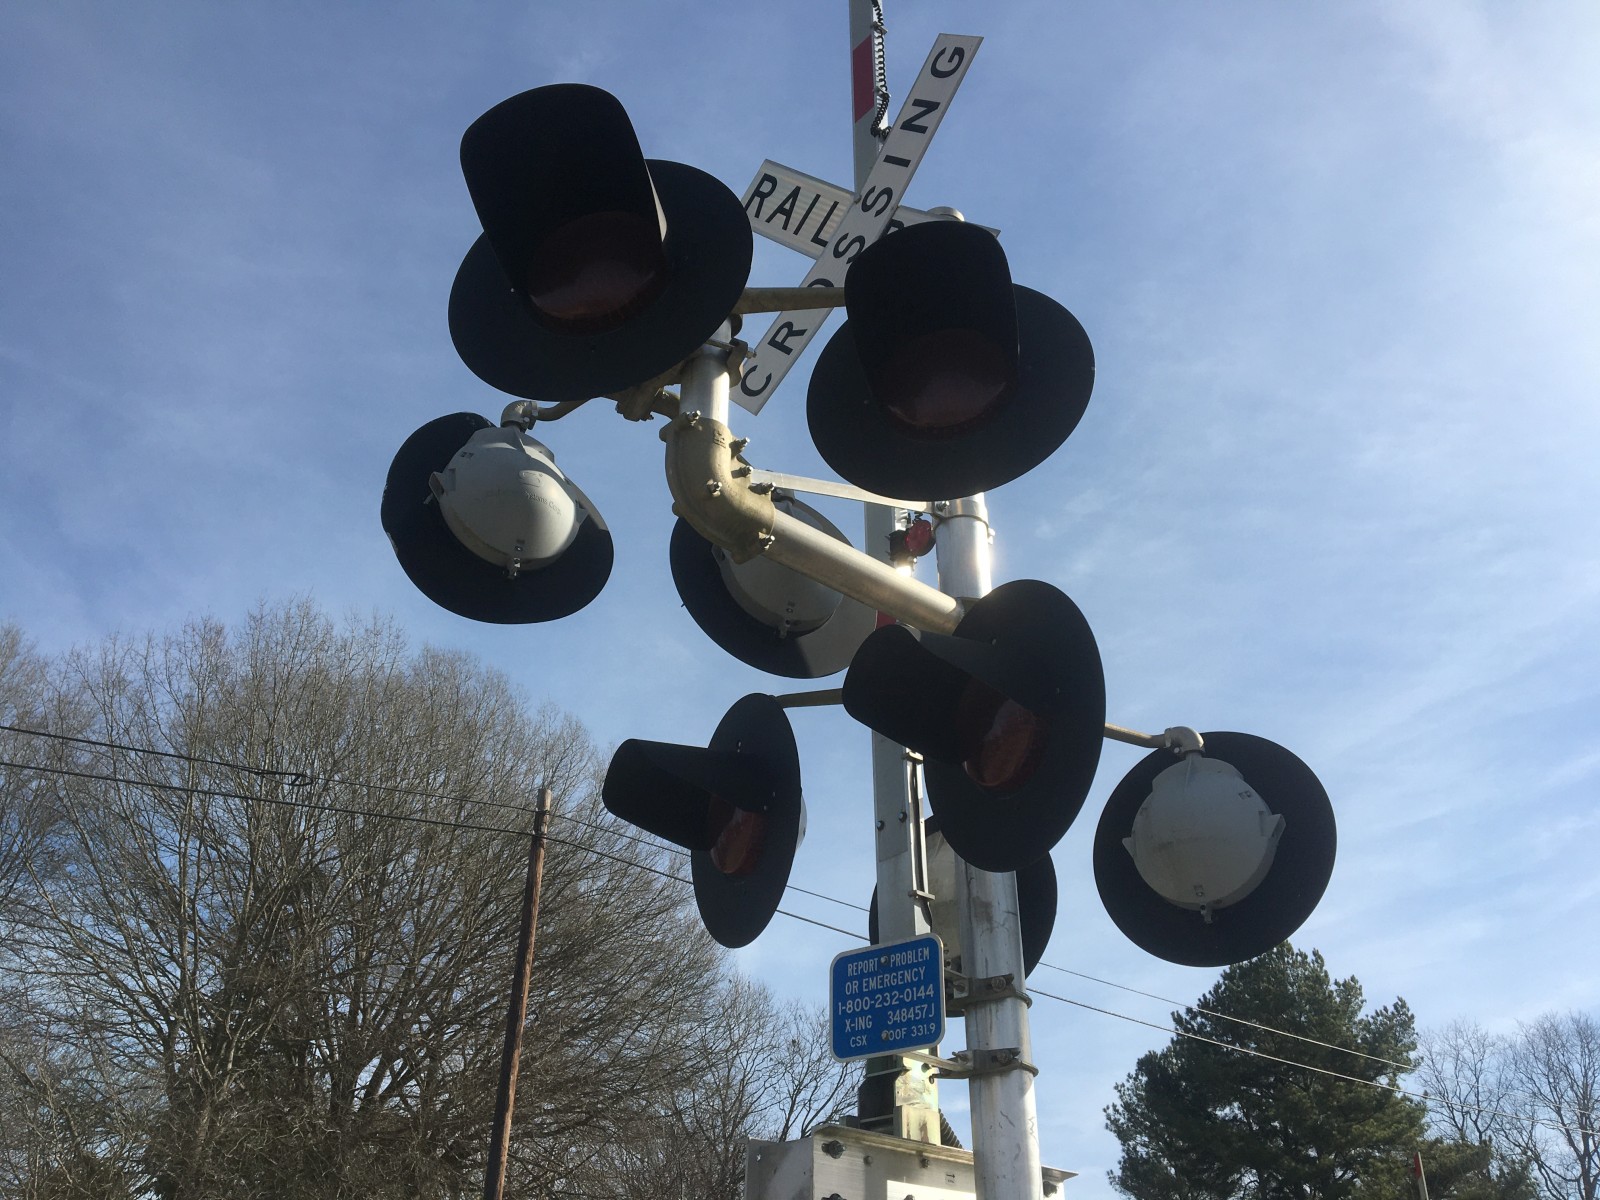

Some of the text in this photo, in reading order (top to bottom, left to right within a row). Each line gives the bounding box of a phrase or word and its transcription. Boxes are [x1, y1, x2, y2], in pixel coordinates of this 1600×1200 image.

[744, 172, 840, 248] RAIL
[847, 946, 930, 977] REPORT PROBLEM
[845, 966, 926, 996] OR EMERGENCY
[838, 983, 934, 1016] 1-800-232-0144
[845, 1002, 935, 1033] X-ING 348457J
[849, 1034, 867, 1048] CSX
[911, 1022, 936, 1037] 331.9
